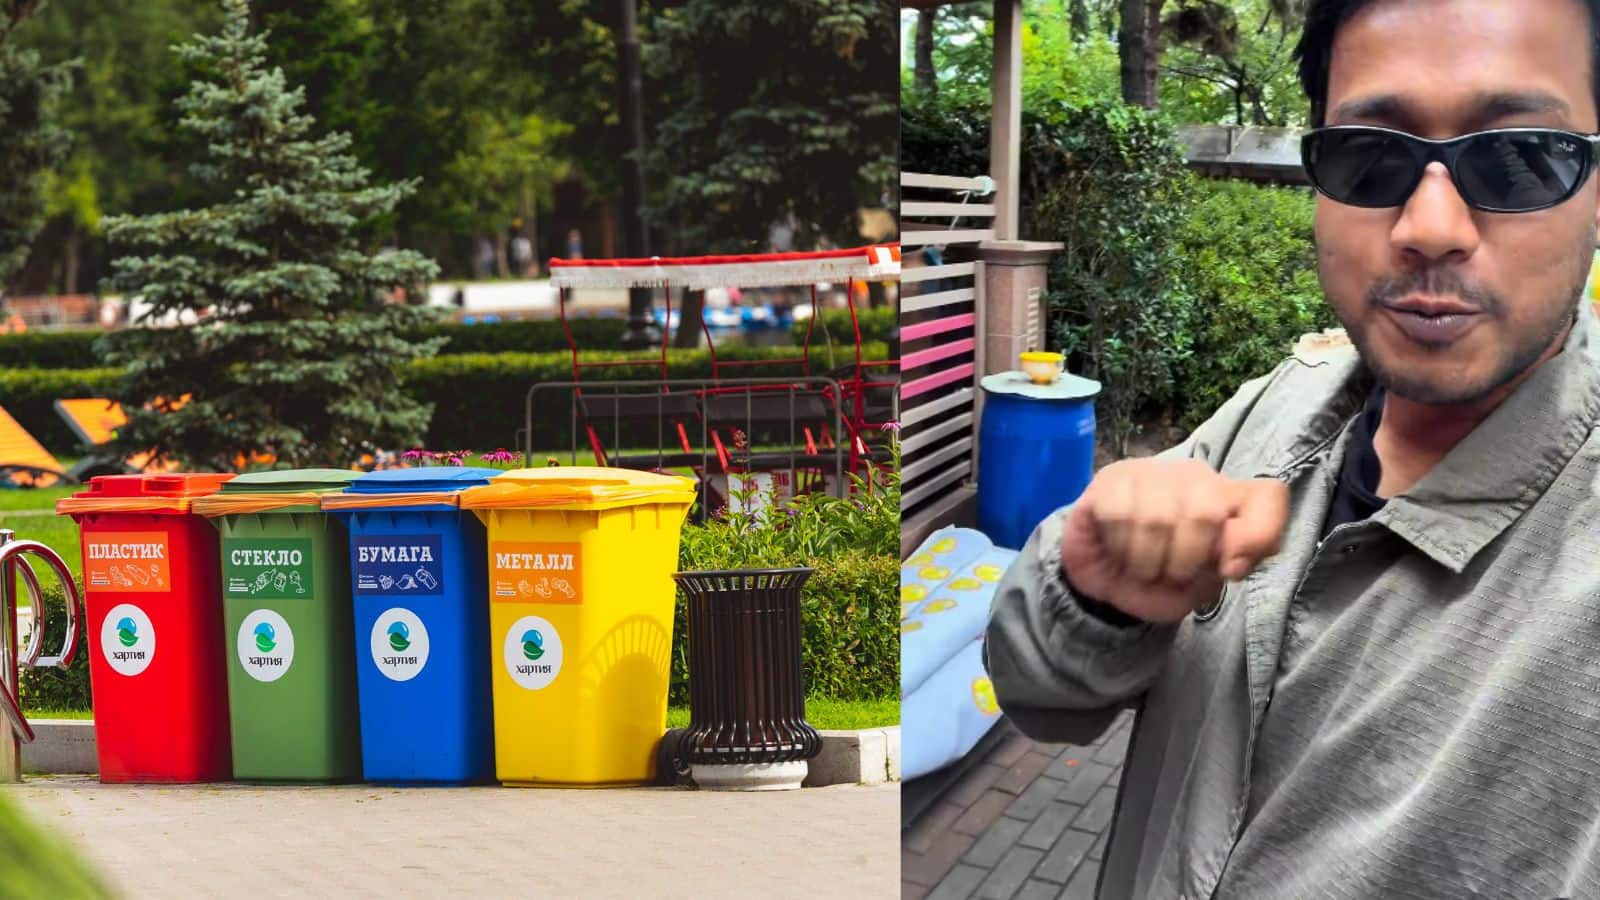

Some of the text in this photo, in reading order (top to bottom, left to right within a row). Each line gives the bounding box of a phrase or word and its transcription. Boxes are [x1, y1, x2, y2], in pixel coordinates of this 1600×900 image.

[88, 543, 164, 559] ПЛАСТИК
[231, 549, 302, 566] СТЕКЛО
[358, 546, 434, 562] БУМАГА
[495, 553, 574, 570] МЕТАЛЛ
[112, 650, 145, 663] хартия
[248, 655, 283, 668] хартия
[382, 656, 417, 668] хартия
[515, 664, 551, 677] хартия
